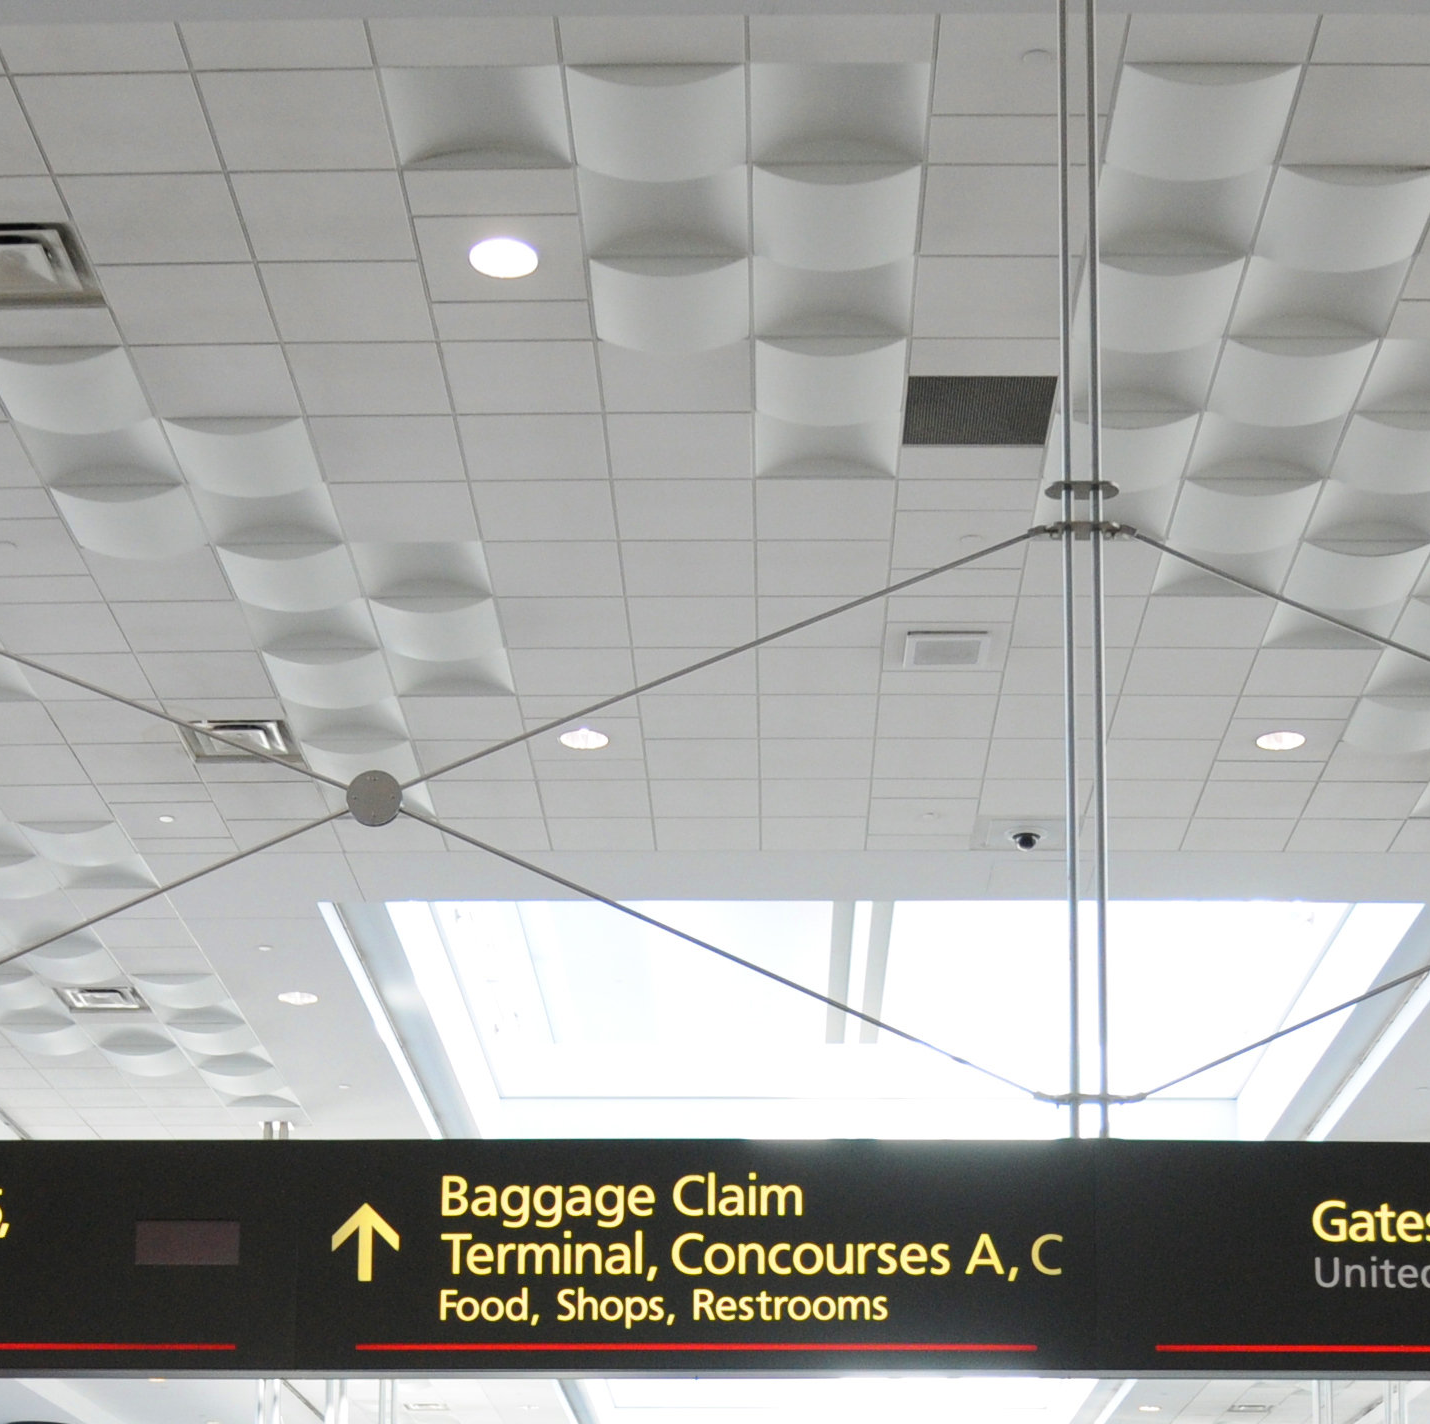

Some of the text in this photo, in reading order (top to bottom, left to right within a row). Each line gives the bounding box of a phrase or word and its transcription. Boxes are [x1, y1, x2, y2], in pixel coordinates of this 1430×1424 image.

[441, 1172, 803, 1228] Baggage Claim
[441, 1232, 1063, 1281] Terminal, Concourses A, C
[440, 1287, 888, 1329] Food, Shops, Restrooms
